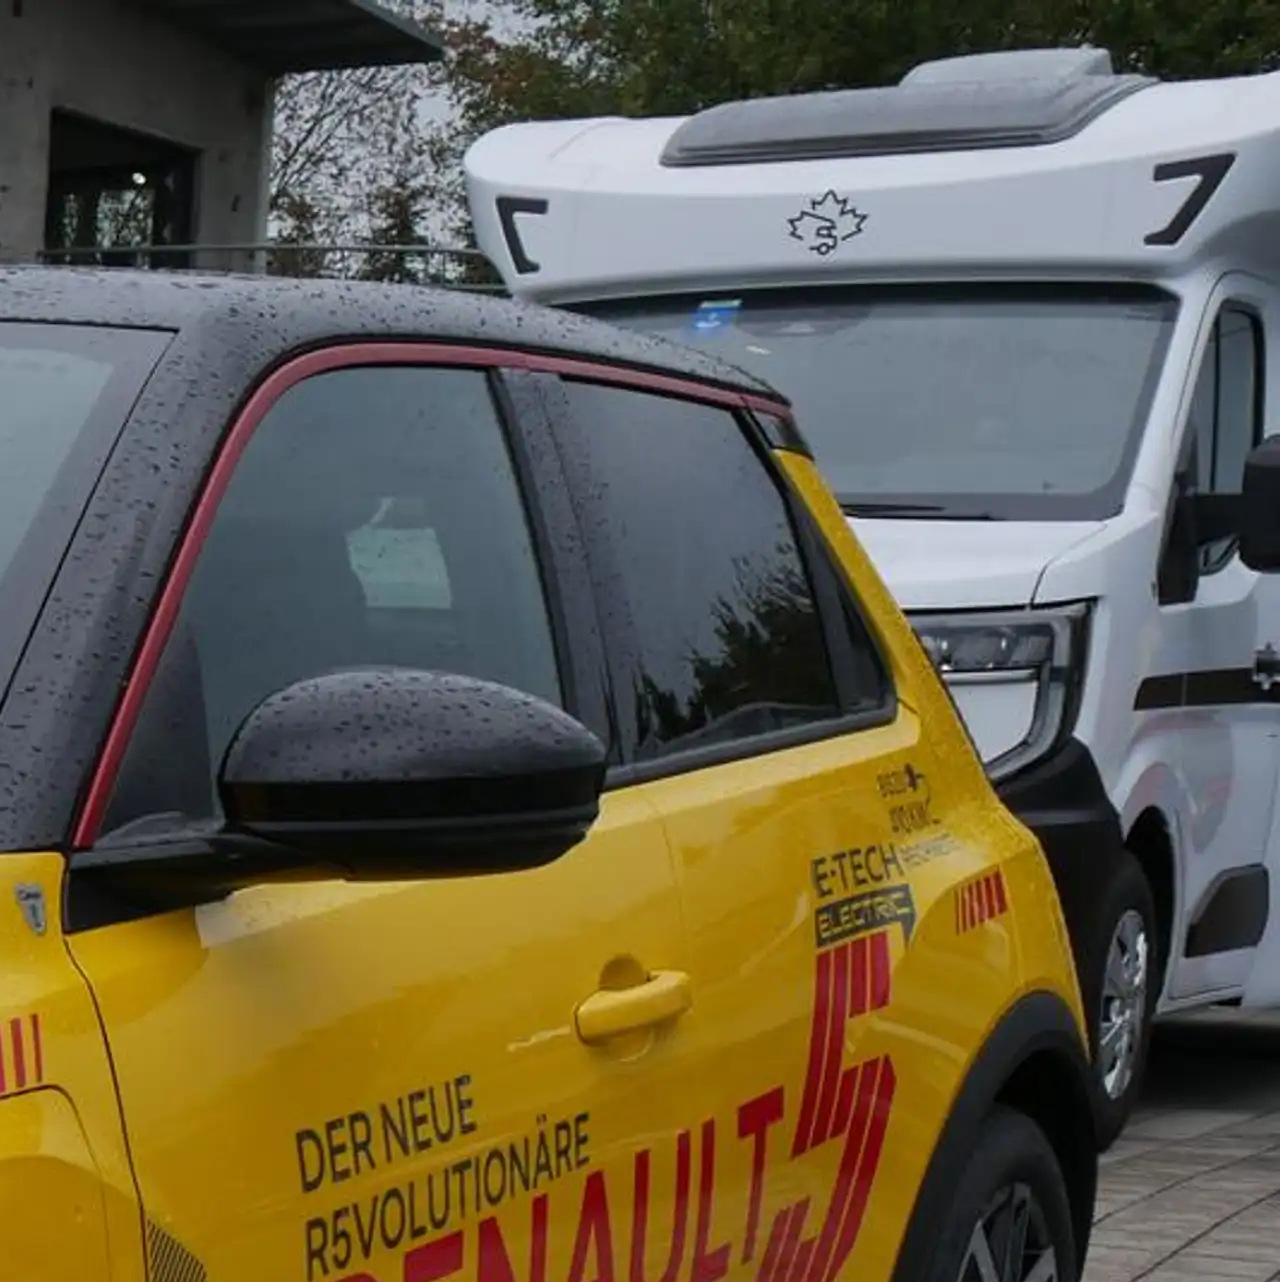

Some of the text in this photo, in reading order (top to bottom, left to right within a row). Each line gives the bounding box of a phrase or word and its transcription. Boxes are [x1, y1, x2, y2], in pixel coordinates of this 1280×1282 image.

[295, 1075, 478, 1193] DER NEUE
[304, 1113, 590, 1282] R5VOLUTIONÄRE
